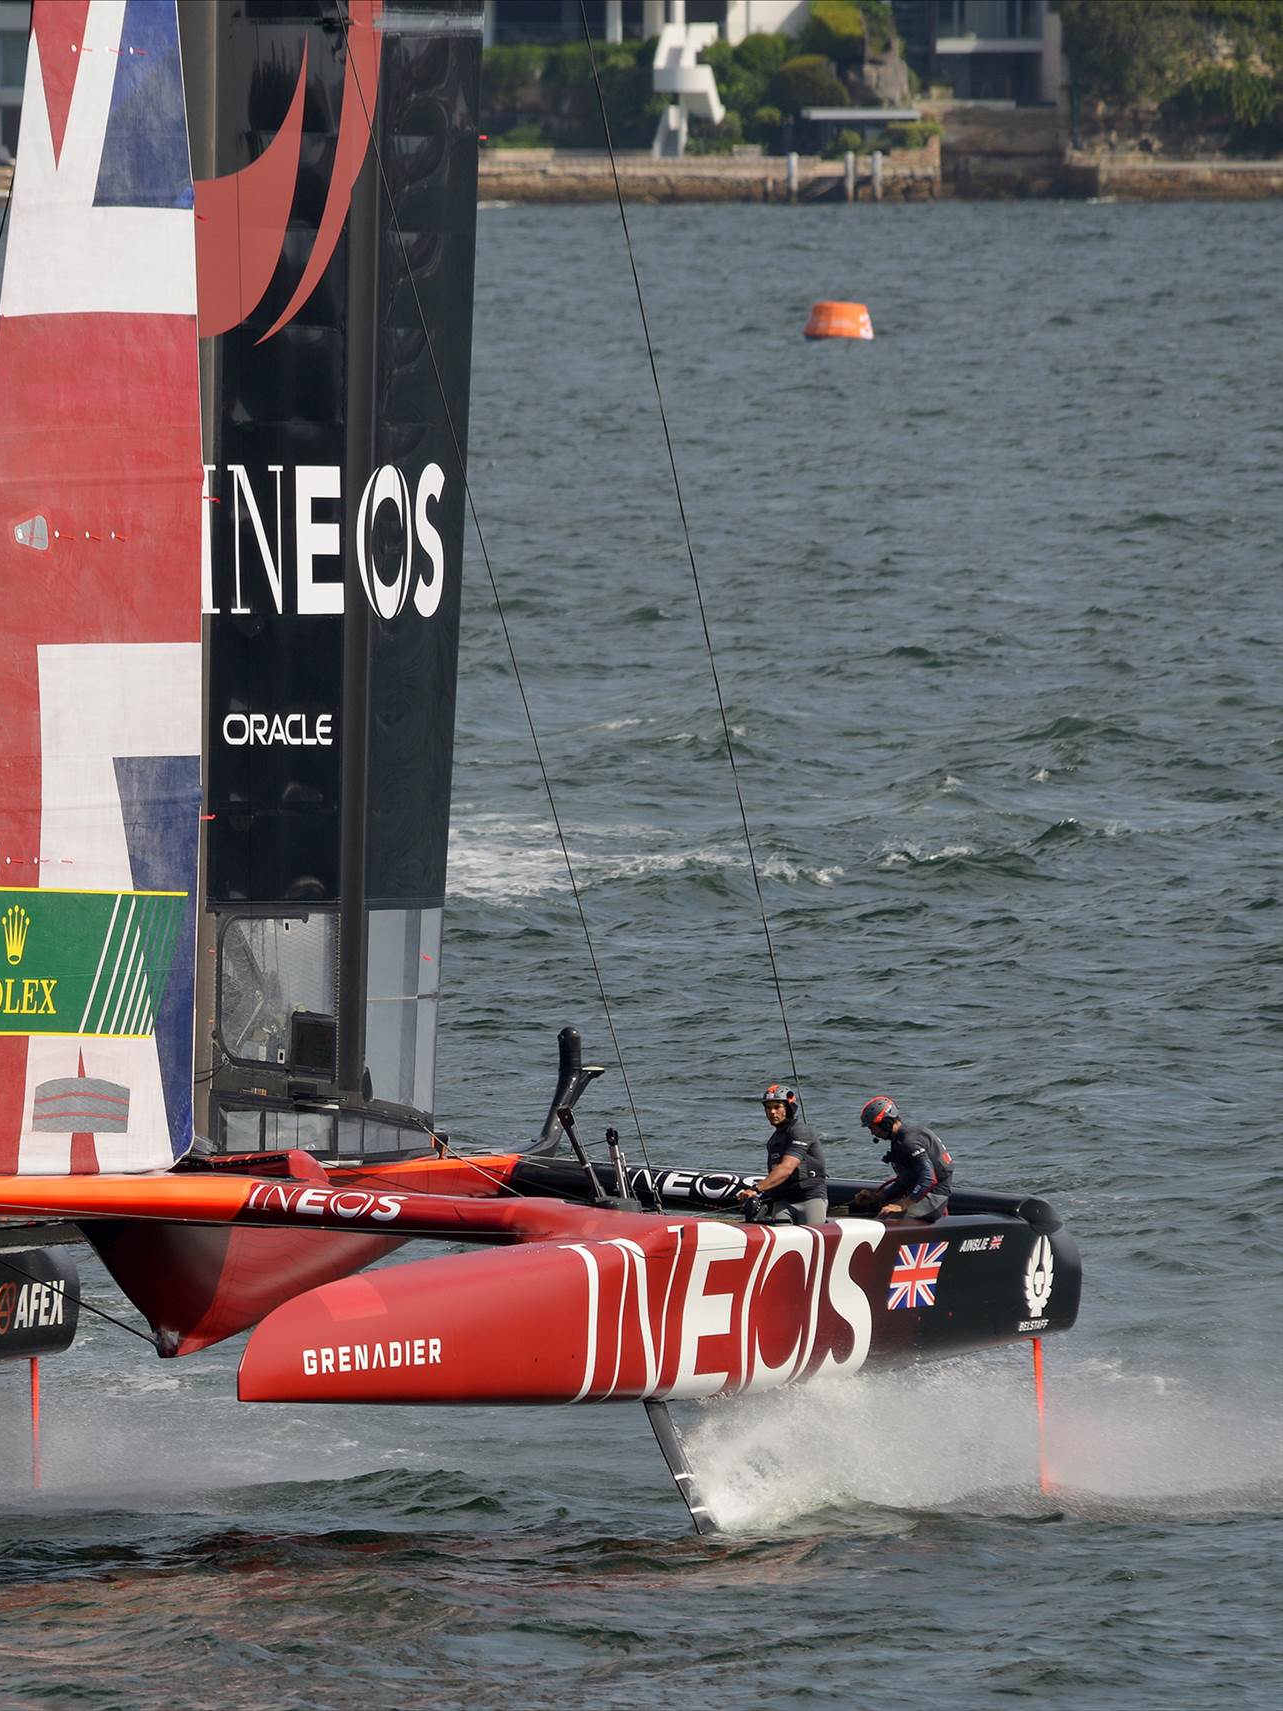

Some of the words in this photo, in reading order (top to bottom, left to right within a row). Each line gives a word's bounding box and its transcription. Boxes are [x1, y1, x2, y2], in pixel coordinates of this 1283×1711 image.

[201, 463, 445, 619] INEOS
[223, 714, 332, 745] ORACLE
[247, 1183, 408, 1221] INEOS
[959, 1238, 990, 1252] AINSLIE
[14, 1280, 65, 1329] AFEX
[557, 1218, 886, 1404] INEOS
[1018, 1319, 1049, 1331] BELSTAFF
[302, 1338, 442, 1376] GRENADIER
